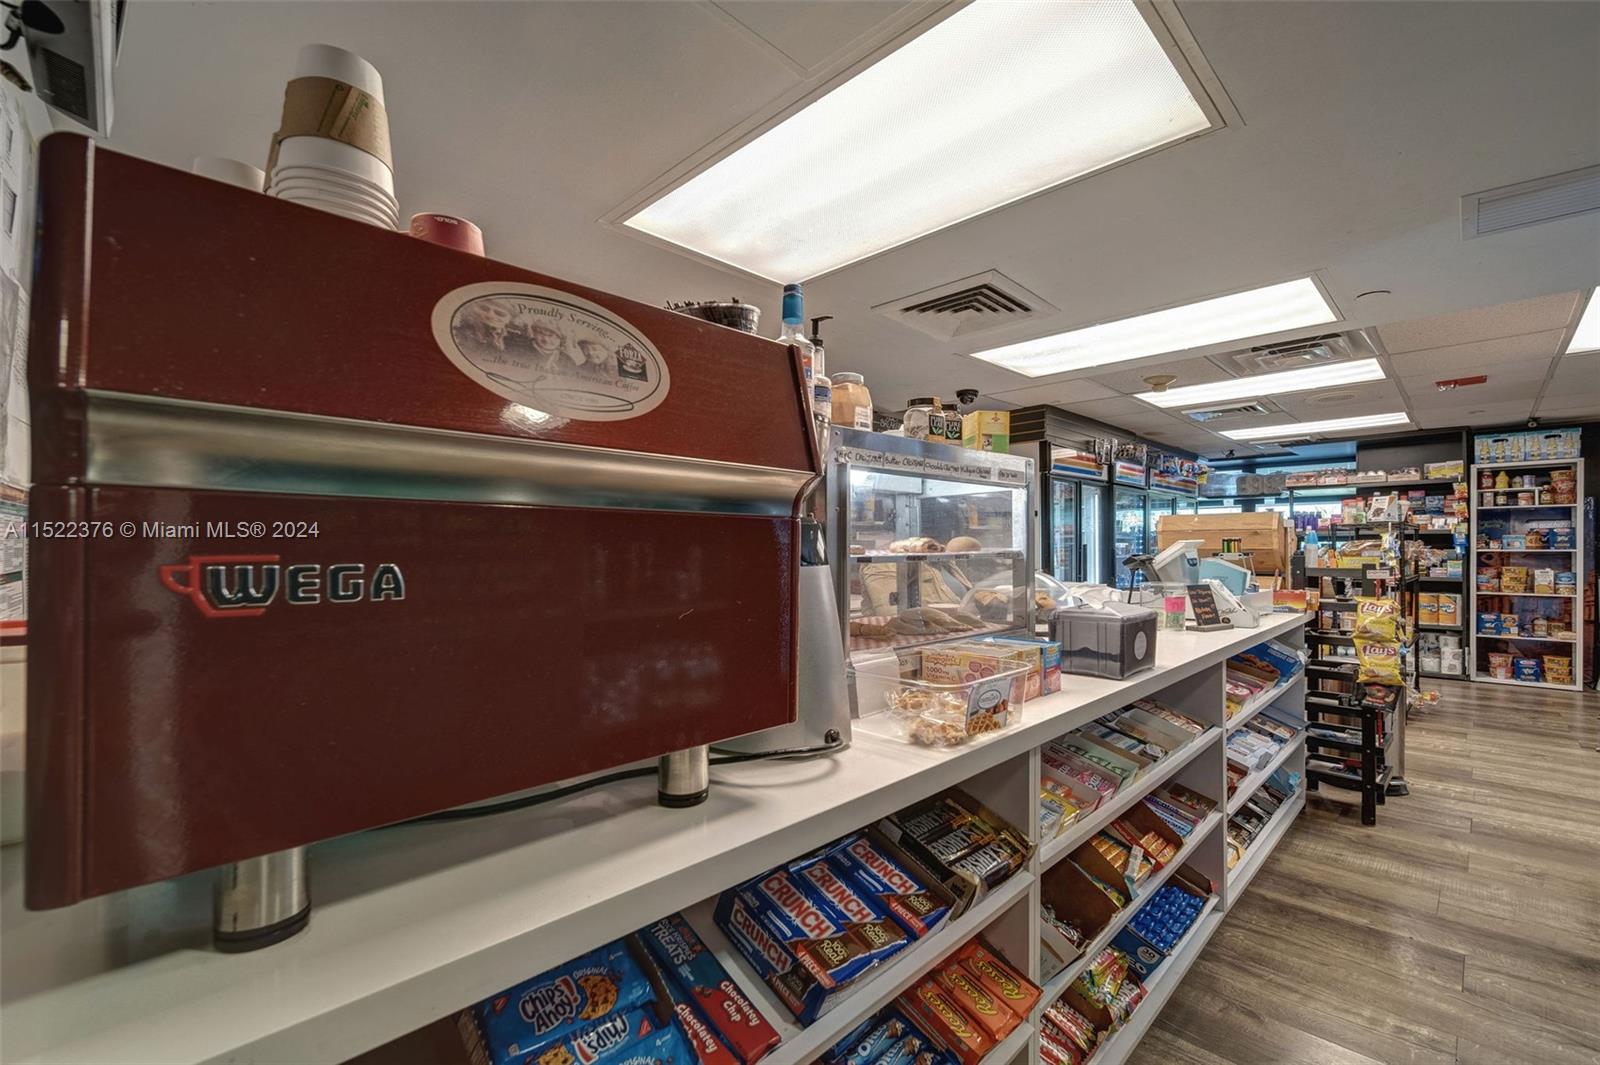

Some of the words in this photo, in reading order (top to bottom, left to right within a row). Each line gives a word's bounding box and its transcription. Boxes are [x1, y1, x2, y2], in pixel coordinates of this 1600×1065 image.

[518, 303, 564, 320] Proudly
[571, 370, 613, 386] American
[614, 380, 640, 393] Coffee
[205, 563, 406, 609] WEGA
[851, 843, 915, 894] CRUNCH
[955, 843, 1008, 879] ERSHEY'S
[762, 875, 833, 938] CRUNCH
[807, 866, 872, 922] CRUNCH
[908, 895, 929, 913] Real
[651, 926, 687, 965] TREATS
[733, 907, 791, 972] CRUNCH
[820, 939, 844, 965] Real
[863, 923, 885, 946] Real
[572, 967, 608, 979] ORIGINAL
[976, 960, 1026, 1000] Reese's
[521, 982, 566, 1020] Chips
[720, 980, 760, 1027] Chocolatey
[723, 1001, 741, 1022] Chip
[949, 973, 999, 1016] Reese's
[676, 1003, 718, 1054] Chocolatey
[923, 991, 973, 1038] Reese's
